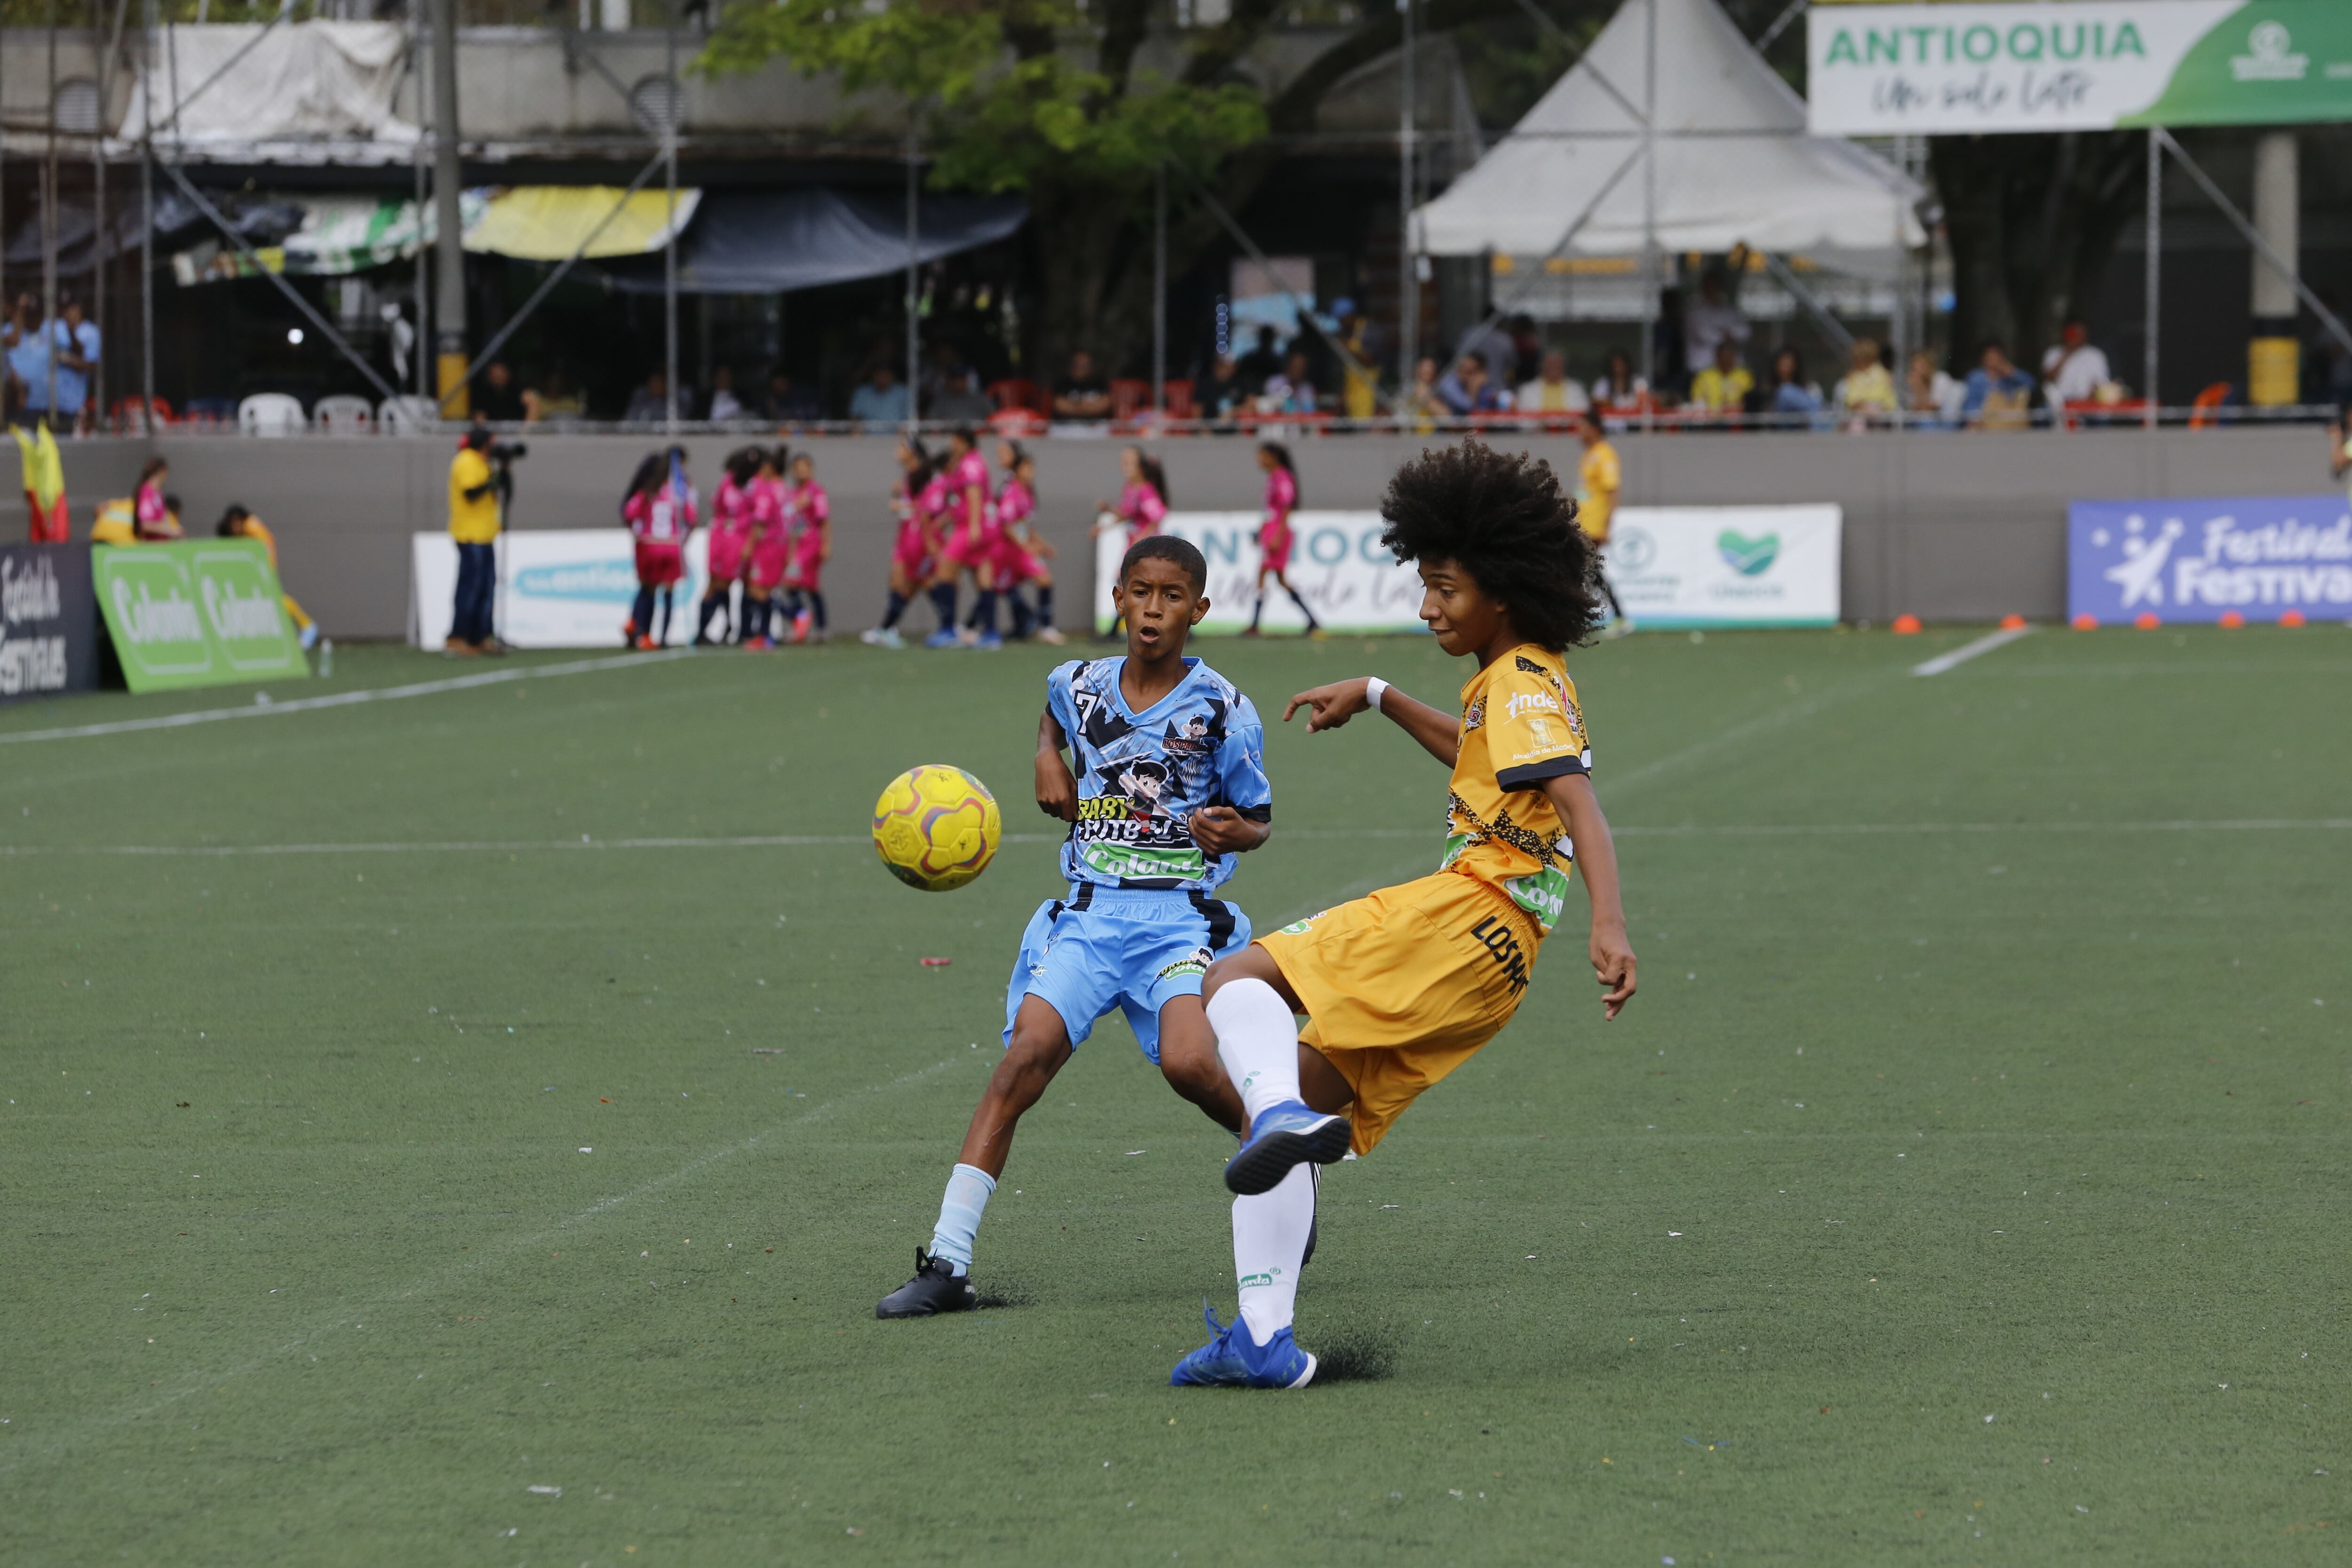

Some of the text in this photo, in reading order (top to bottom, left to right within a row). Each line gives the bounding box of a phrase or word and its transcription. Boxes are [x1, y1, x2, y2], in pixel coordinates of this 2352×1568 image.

[1825, 22, 2146, 66] ANTIOQUIA
[1075, 691, 1098, 735] 7
[1505, 691, 1559, 718] inde
[1163, 739, 1180, 749] LOS
[1512, 749, 1541, 760] Alcaldía
